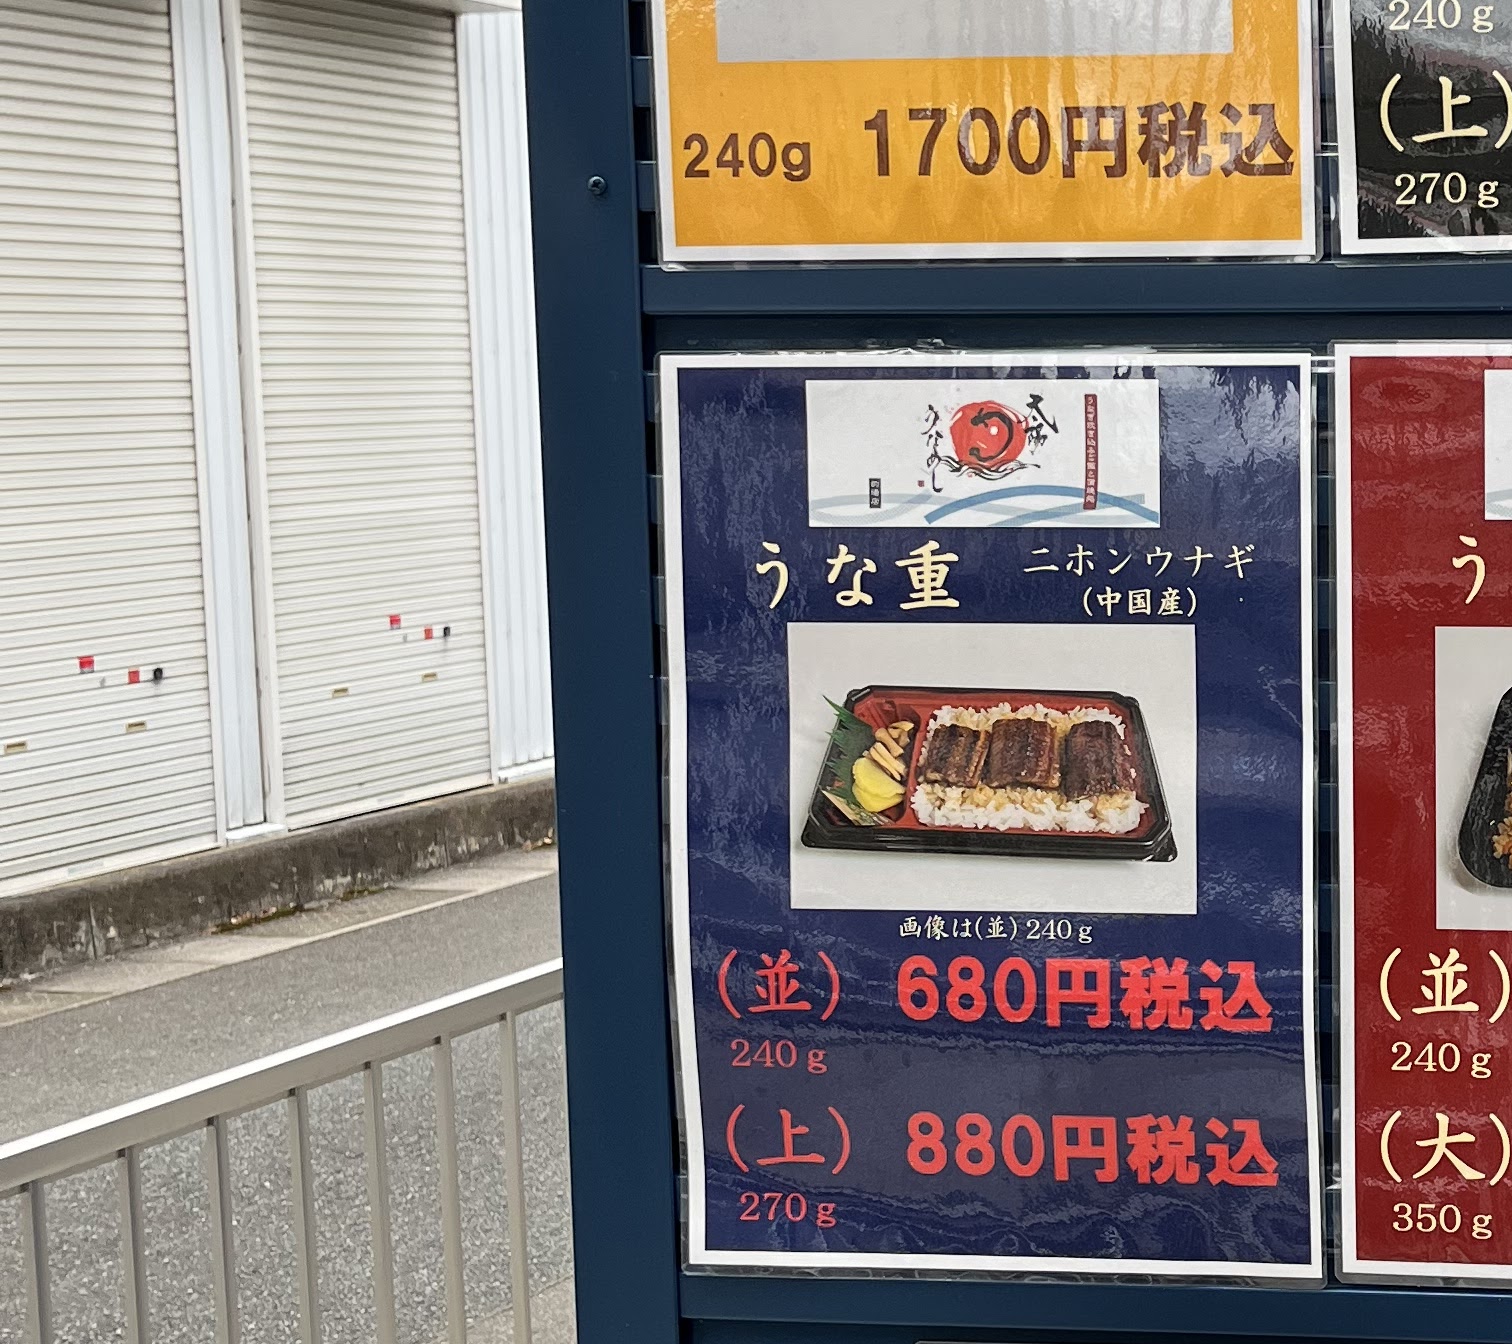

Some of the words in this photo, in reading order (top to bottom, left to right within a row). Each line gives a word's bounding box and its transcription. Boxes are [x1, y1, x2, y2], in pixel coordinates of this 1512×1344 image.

[682, 131, 812, 182] 240g
[863, 101, 1295, 179] 1700円税込
[1394, 172, 1501, 210] 270g
[754, 538, 961, 612] うな重
[1022, 543, 1256, 581] ニホンウナギ
[1082, 585, 1199, 619] (中国産)
[717, 948, 841, 1021] （並）
[896, 954, 1274, 1034] 680円税込
[1379, 946, 1511, 1023] （並）
[730, 1039, 828, 1074] 240g
[1390, 1041, 1493, 1079] 240g
[725, 1103, 852, 1176] （上）
[906, 1111, 1280, 1188] 880円税込
[1379, 1109, 1511, 1187] （大）
[739, 1192, 837, 1228] 270g
[1391, 1202, 1494, 1240] 350g
